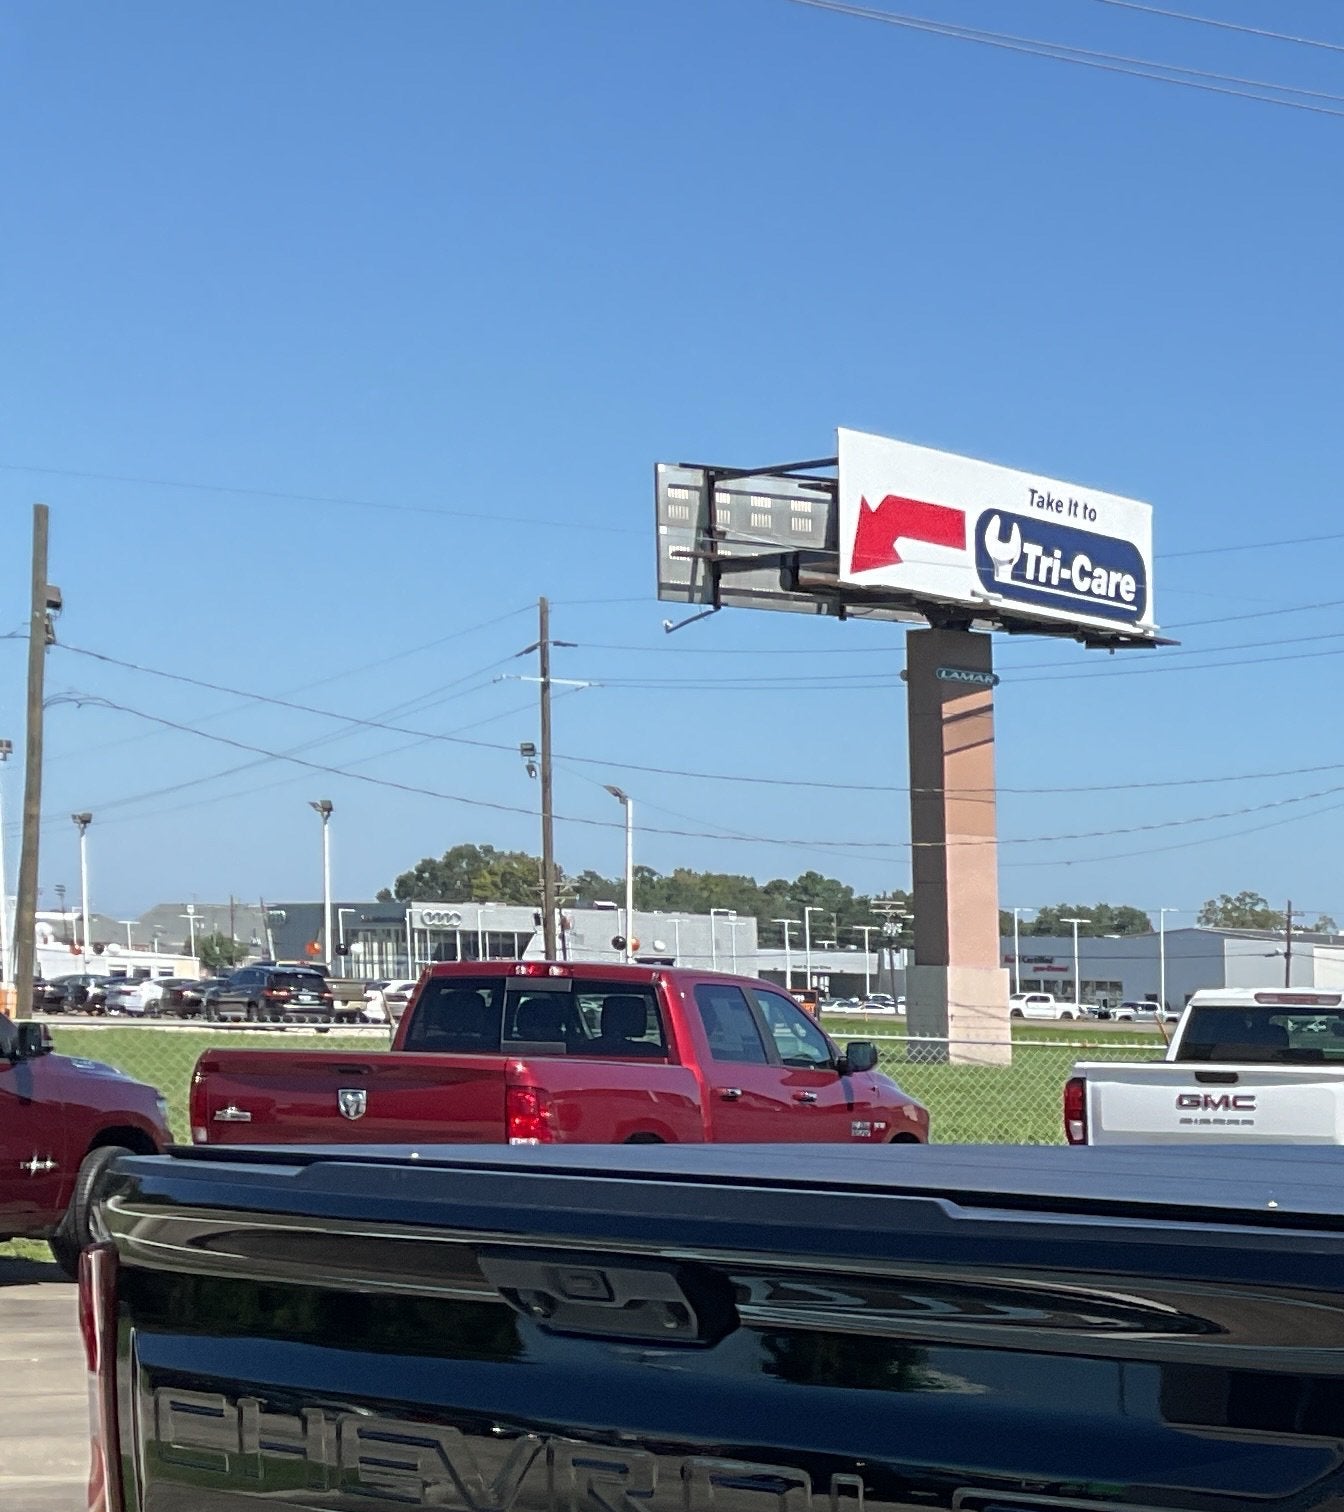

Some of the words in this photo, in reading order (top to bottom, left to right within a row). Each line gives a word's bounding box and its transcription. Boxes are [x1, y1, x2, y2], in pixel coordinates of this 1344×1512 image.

[1029, 488, 1064, 514] Take
[1068, 497, 1079, 518] It
[1083, 502, 1098, 522] to
[1022, 542, 1137, 602] Tri-Care
[940, 670, 994, 683] LAMAR
[1176, 1093, 1257, 1112] GMC
